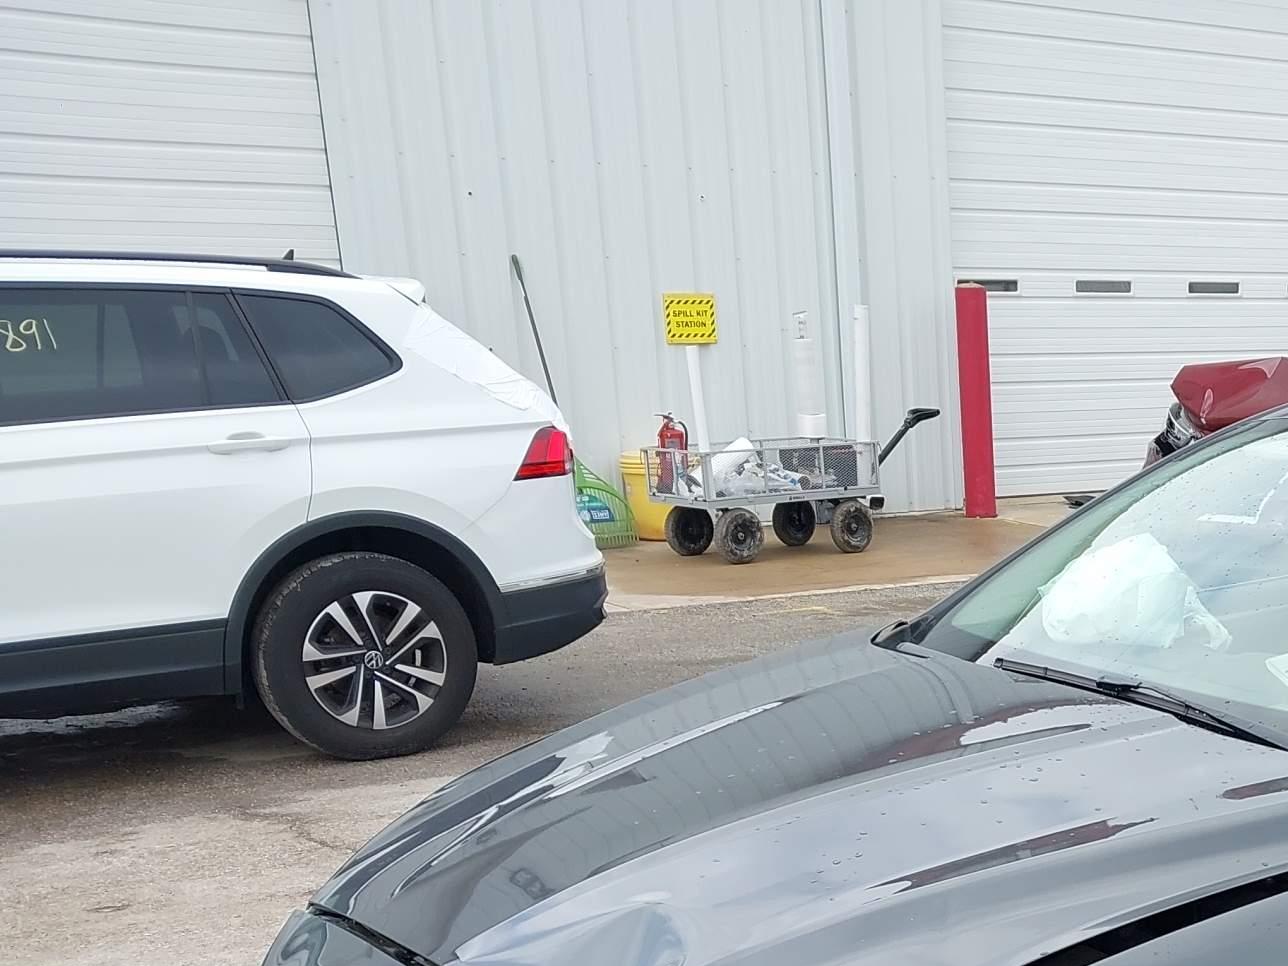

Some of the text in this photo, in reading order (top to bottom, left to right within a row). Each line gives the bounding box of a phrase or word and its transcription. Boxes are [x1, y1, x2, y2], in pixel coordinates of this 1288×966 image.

[672, 309, 709, 318] SPILL KIT
[675, 320, 707, 328] STATION
